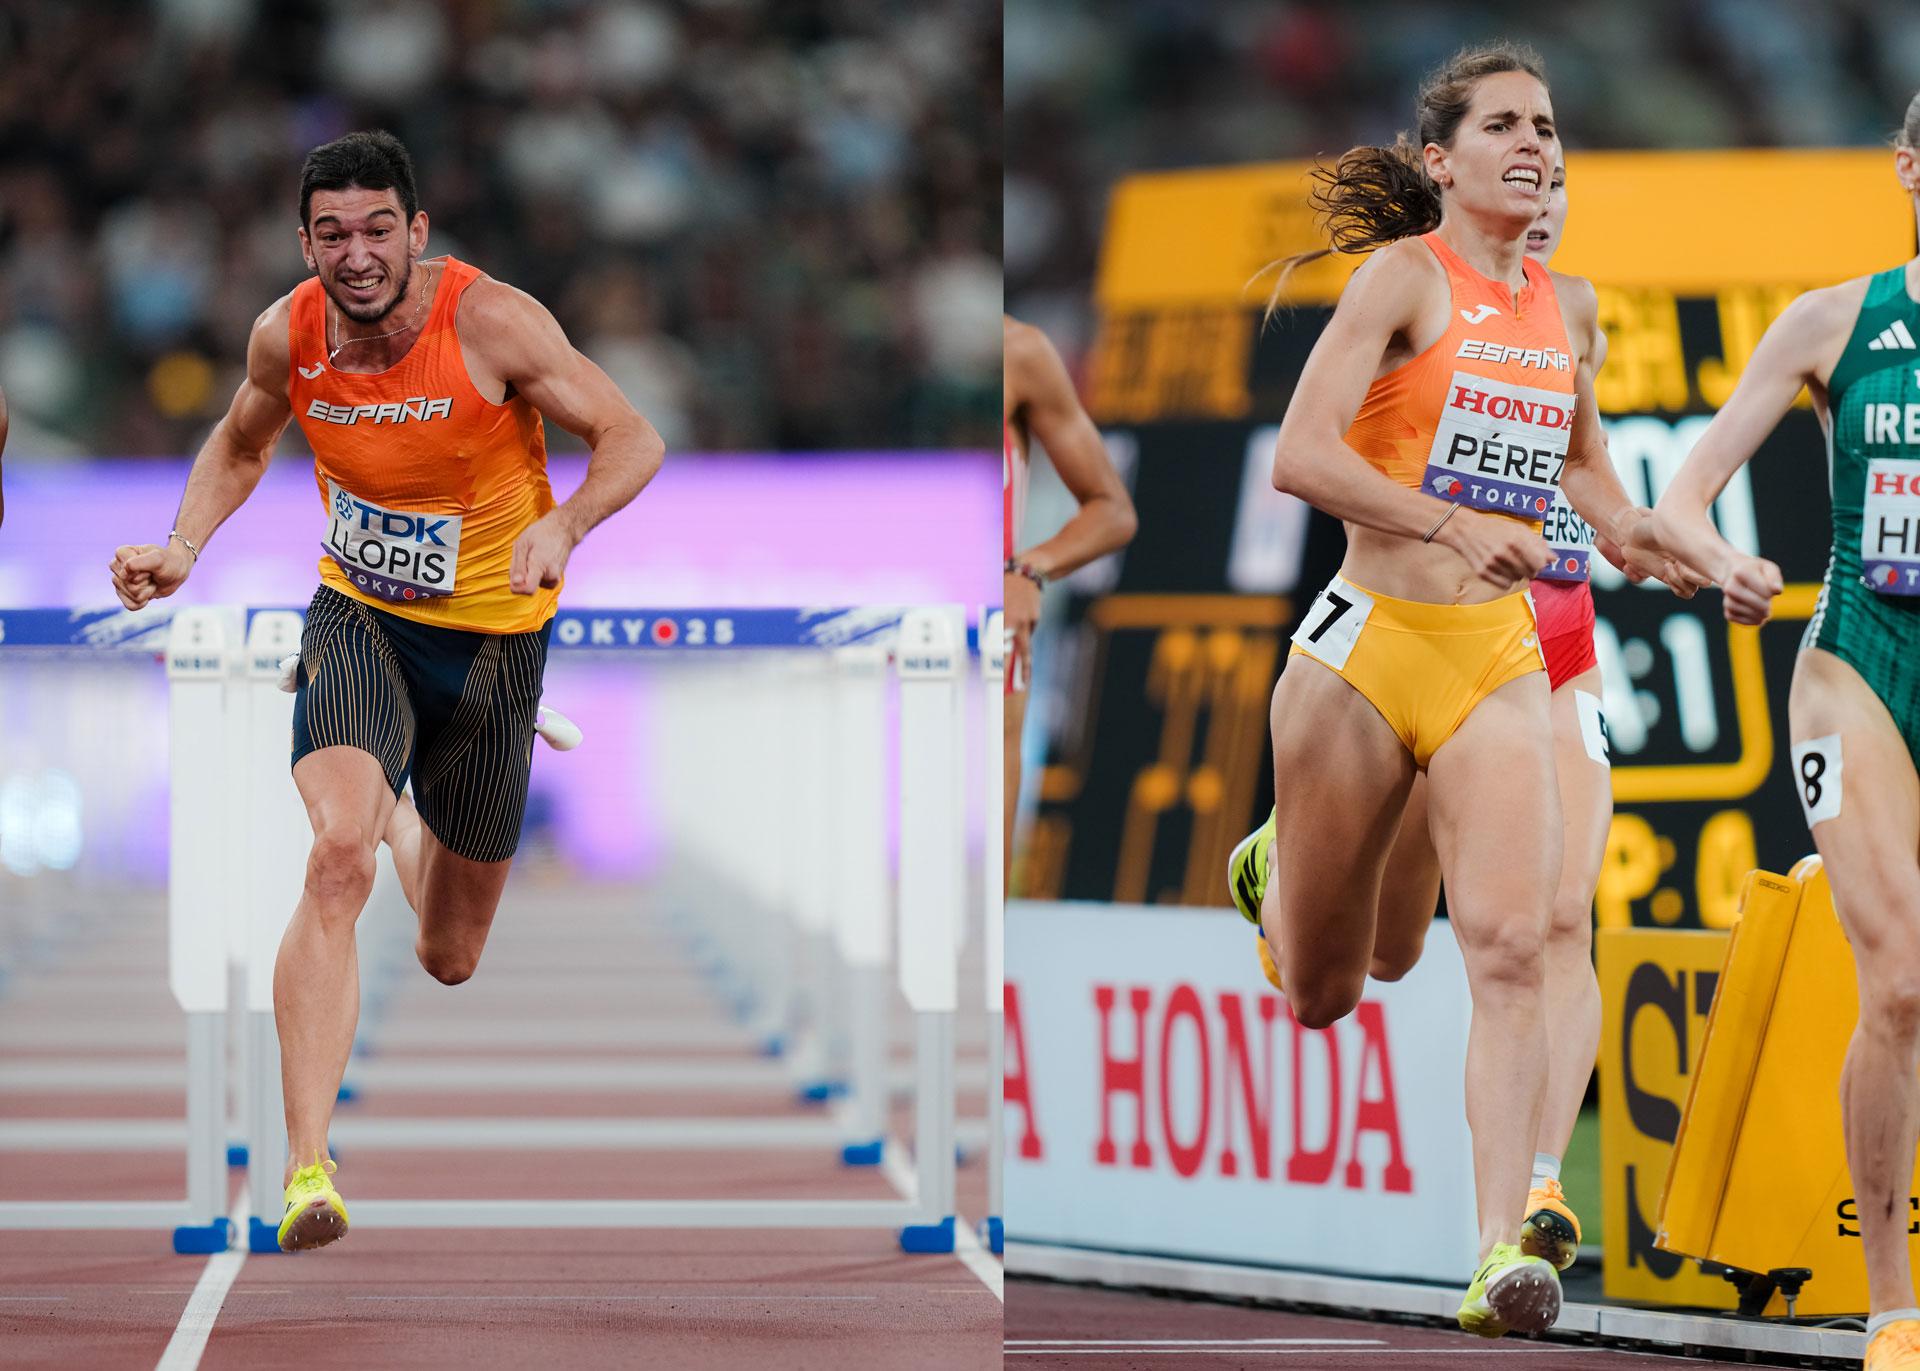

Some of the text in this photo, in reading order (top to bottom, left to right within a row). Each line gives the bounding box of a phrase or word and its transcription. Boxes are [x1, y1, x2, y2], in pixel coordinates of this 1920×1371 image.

[1455, 338, 1571, 373] ESPAÑA
[306, 396, 453, 425] ESPAÑA
[1446, 432, 1567, 486] PÉREZ
[353, 500, 450, 546] TDK
[1878, 516, 1920, 554] H
[331, 519, 445, 584] LLOPIS
[1307, 590, 1354, 644] 7
[1801, 752, 1826, 808] 8
[1094, 982, 1414, 1193] HONDA
